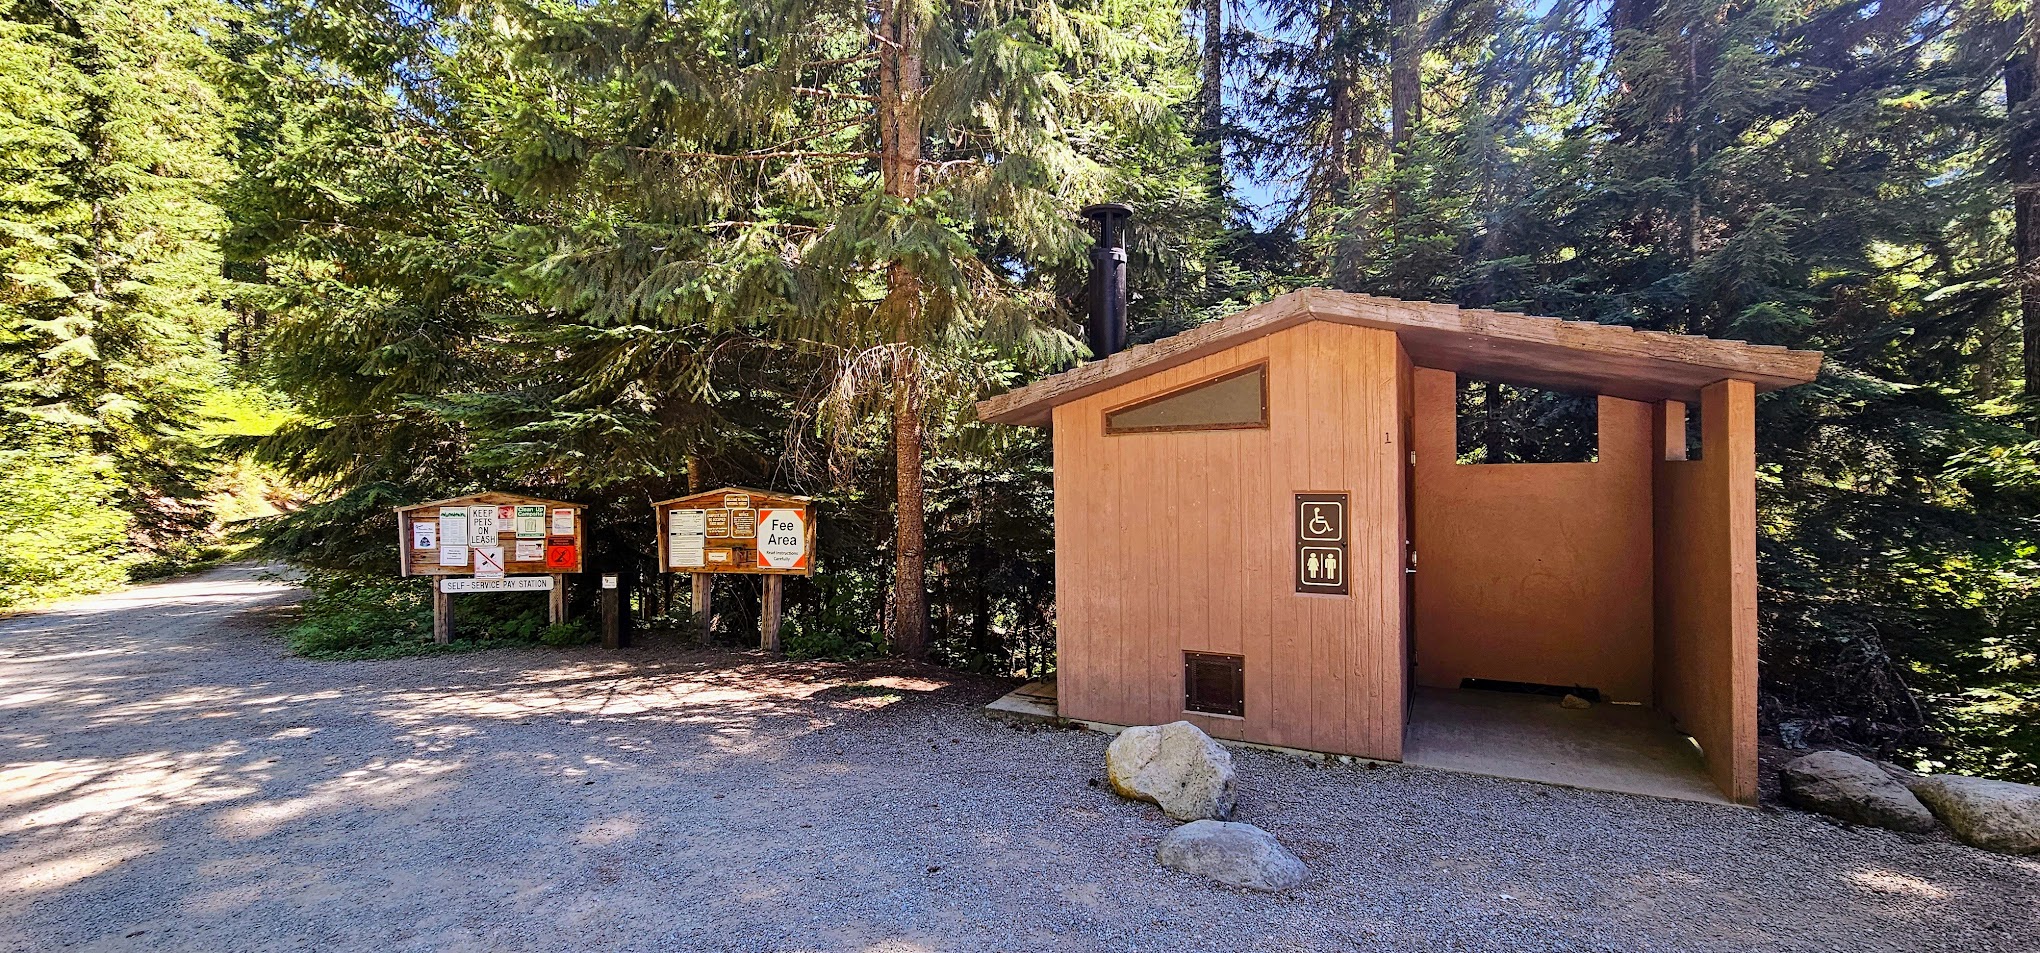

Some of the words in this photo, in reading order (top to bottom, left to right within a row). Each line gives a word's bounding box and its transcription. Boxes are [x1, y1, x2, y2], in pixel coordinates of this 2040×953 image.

[1385, 432, 1391, 444] 1
[473, 509, 493, 517] KEEP
[474, 518, 492, 526] PETS
[772, 519, 794, 531] Fee
[471, 535, 495, 544] LEASH
[767, 533, 797, 546] Area
[503, 580, 516, 589] PAY
[519, 579, 547, 588] STATION
